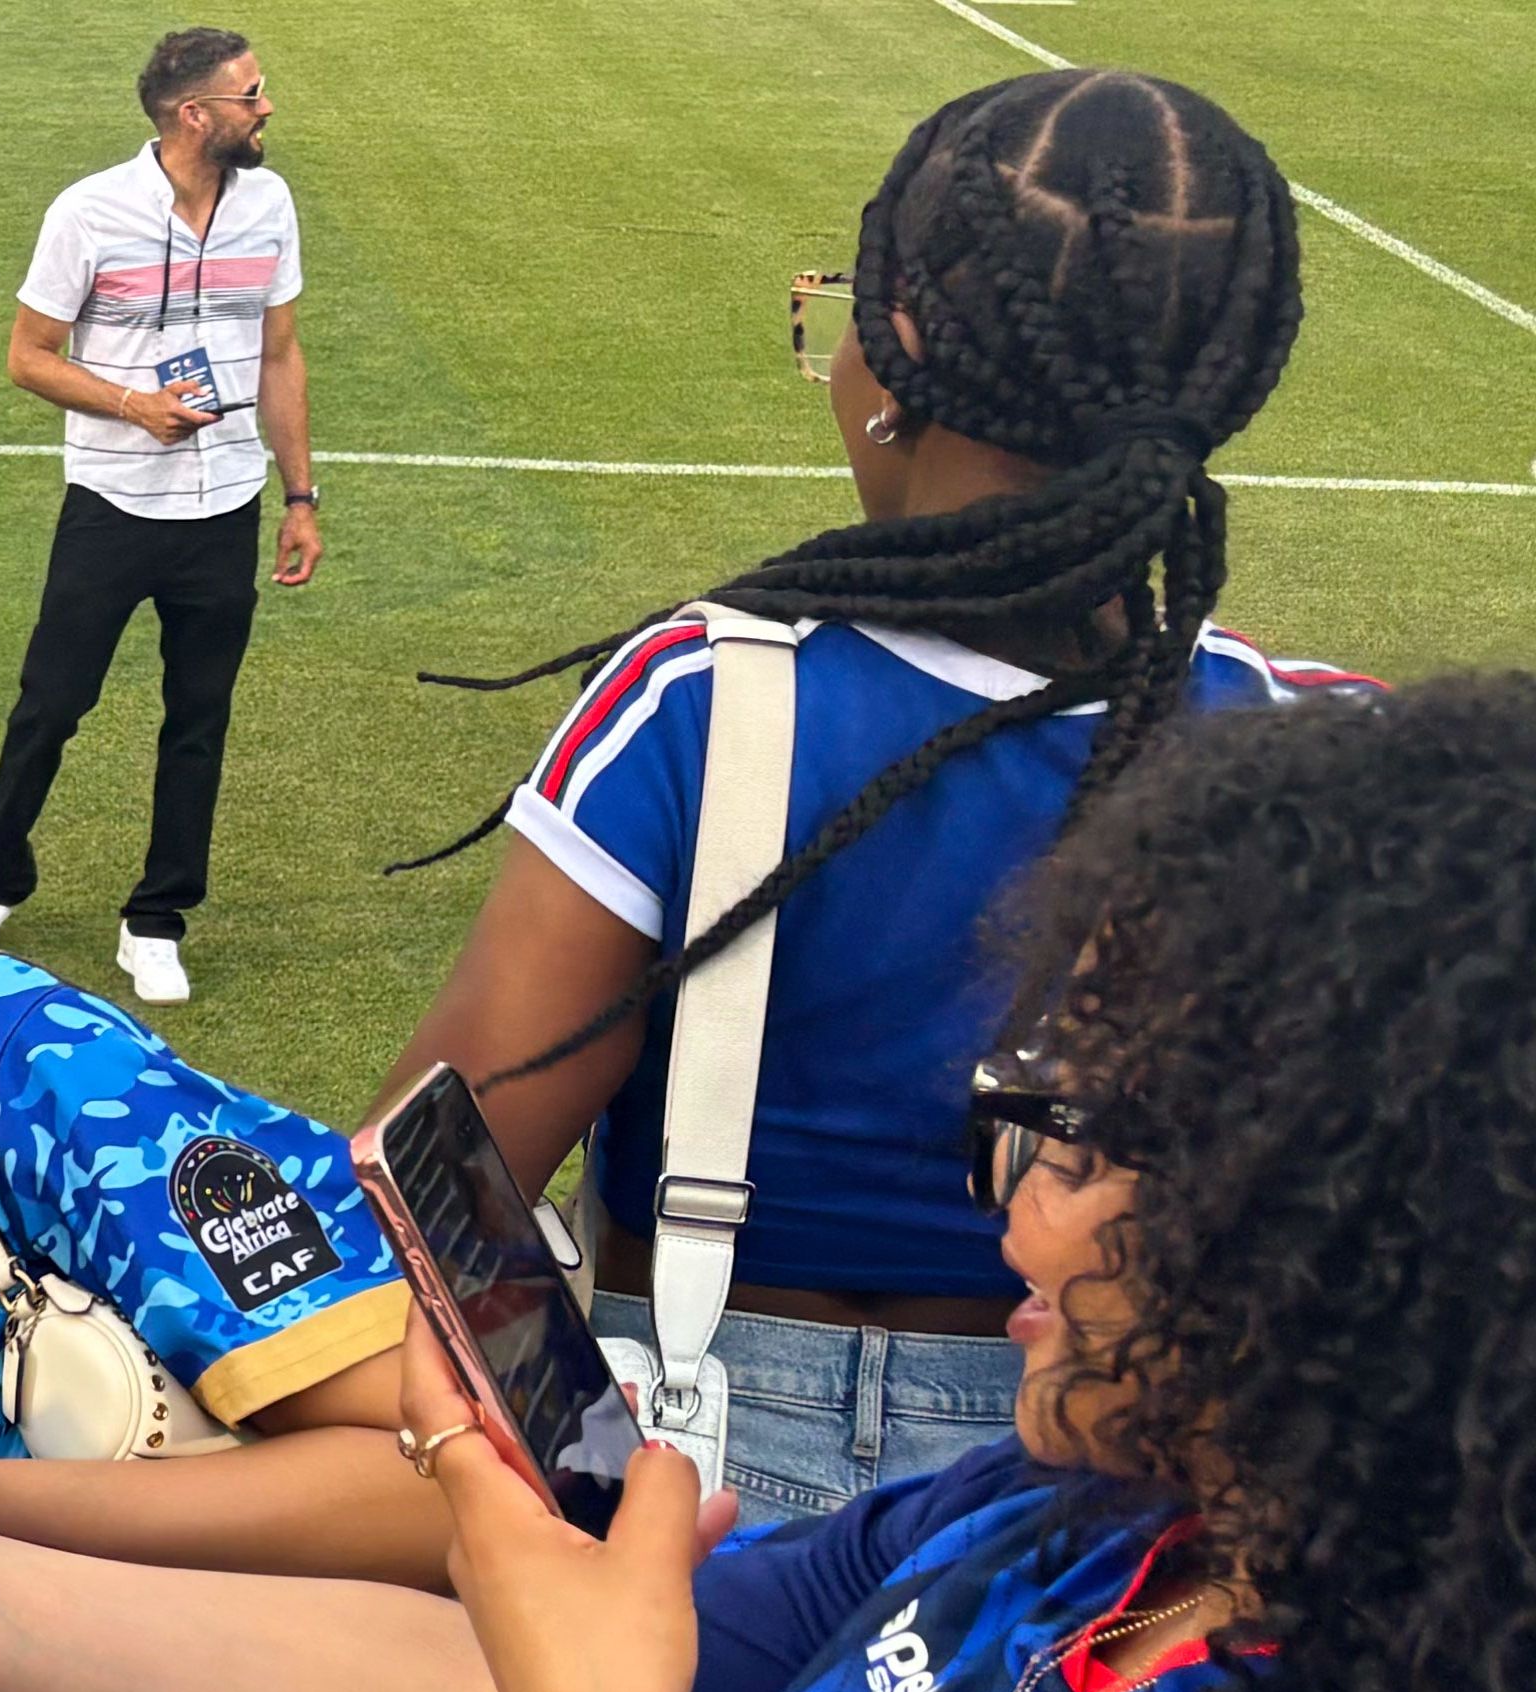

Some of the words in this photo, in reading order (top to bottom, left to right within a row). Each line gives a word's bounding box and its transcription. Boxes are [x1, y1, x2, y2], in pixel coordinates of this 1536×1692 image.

[200, 1192, 299, 1254] Celebrate
[231, 1220, 293, 1265] Africa
[242, 1248, 316, 1296] CAF
